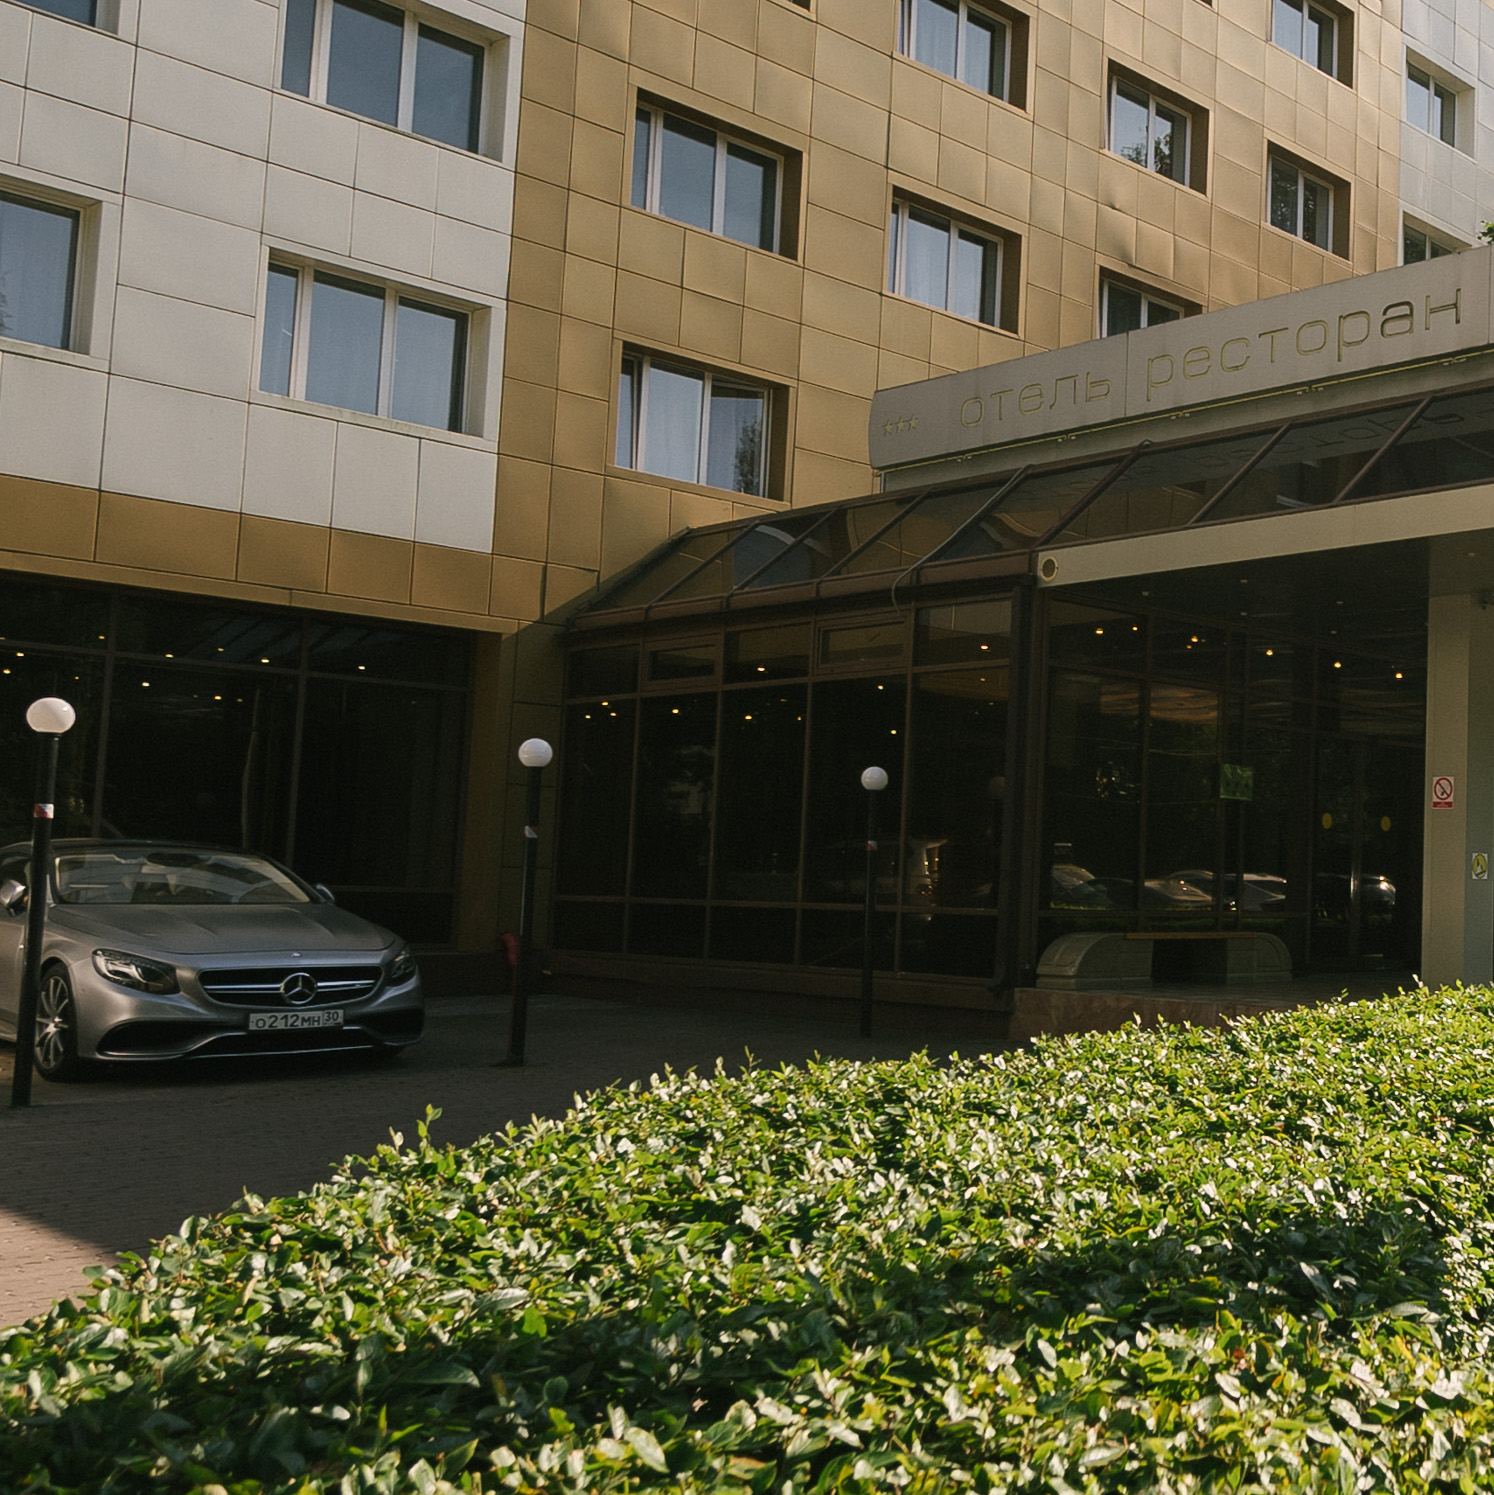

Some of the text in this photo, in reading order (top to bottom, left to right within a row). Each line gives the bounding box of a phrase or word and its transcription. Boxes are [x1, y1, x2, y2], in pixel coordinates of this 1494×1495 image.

[960, 287, 1462, 429] отель ресторан
[324, 1011, 340, 1022] 30
